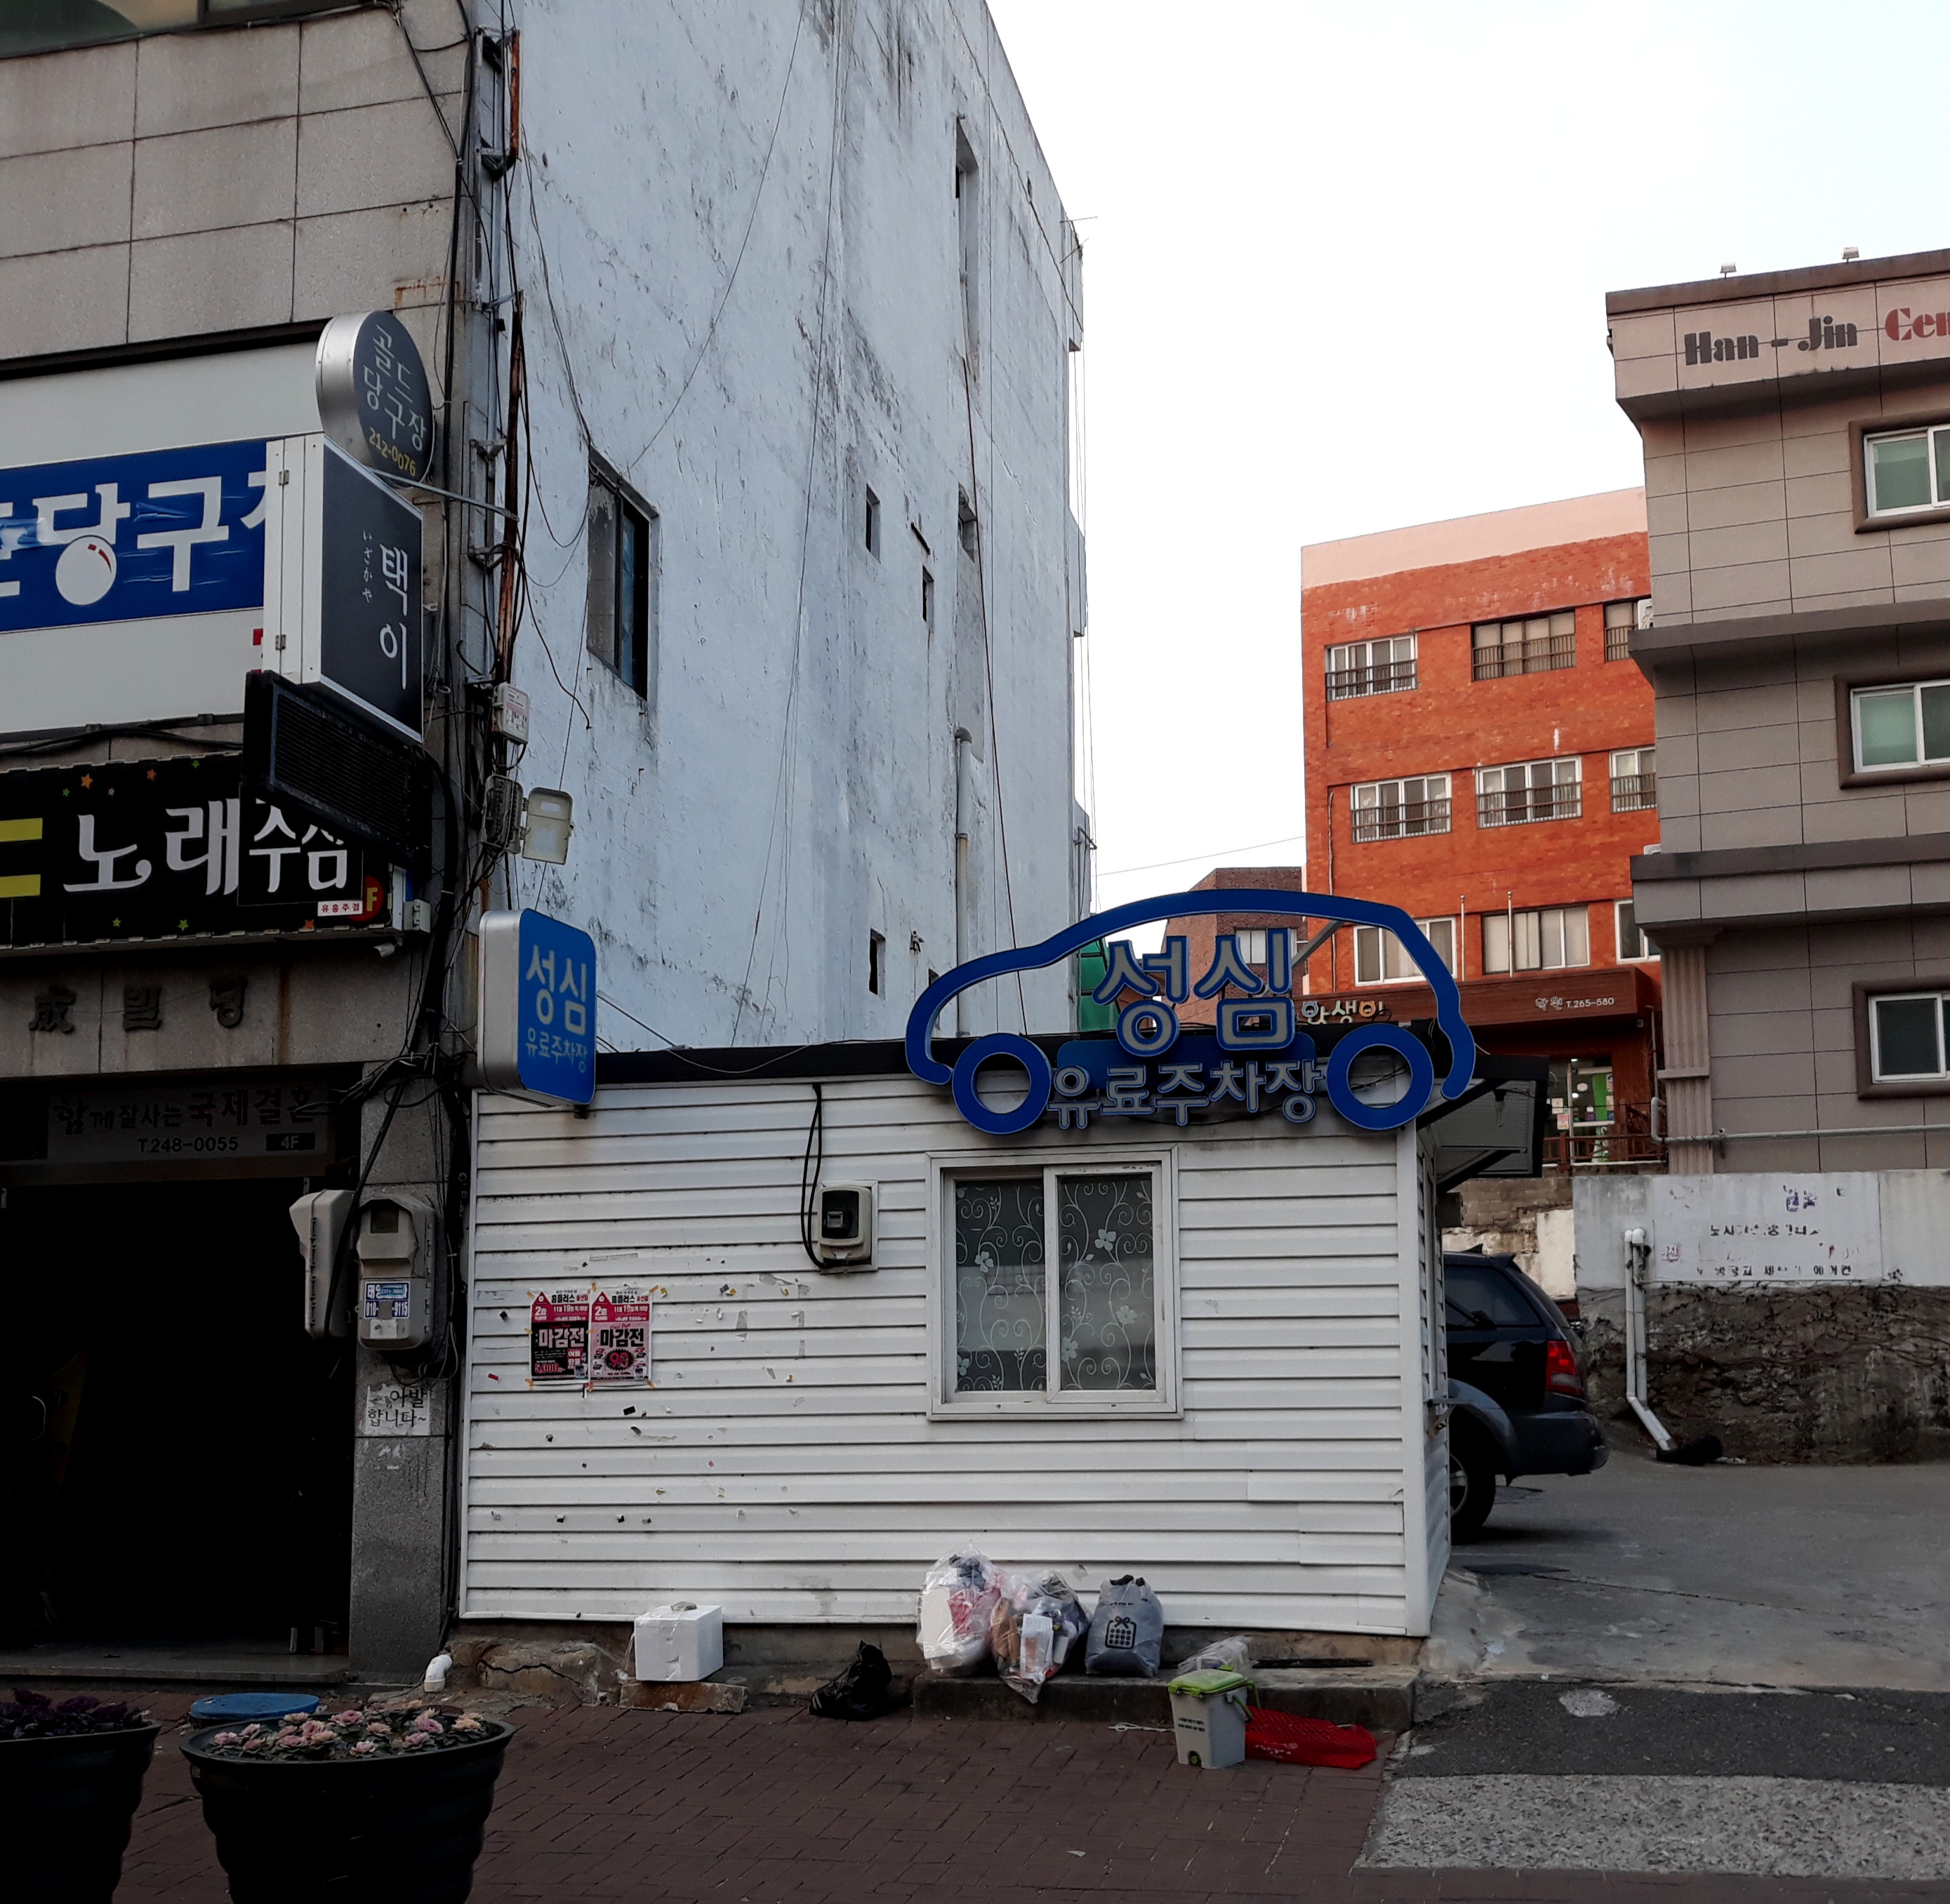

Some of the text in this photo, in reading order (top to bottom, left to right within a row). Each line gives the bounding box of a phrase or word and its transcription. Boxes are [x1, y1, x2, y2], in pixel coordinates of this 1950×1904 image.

[373, 324, 413, 404] 골드
[364, 365, 427, 451] 당구장
[369, 427, 416, 477] 212-0076
[379, 544, 408, 691] 택이
[321, 903, 360, 914] 유흥주점
[526, 944, 588, 1037] 성심
[1092, 928, 1296, 1057] 성심
[525, 1027, 588, 1074] 유료주차장
[187, 1086, 316, 1127] 국제결혼
[1047, 1060, 1325, 1130] 유료주차장
[280, 1134, 300, 1150] 4F
[538, 1327, 585, 1348] 마감전
[600, 1328, 644, 1347] 마감전
